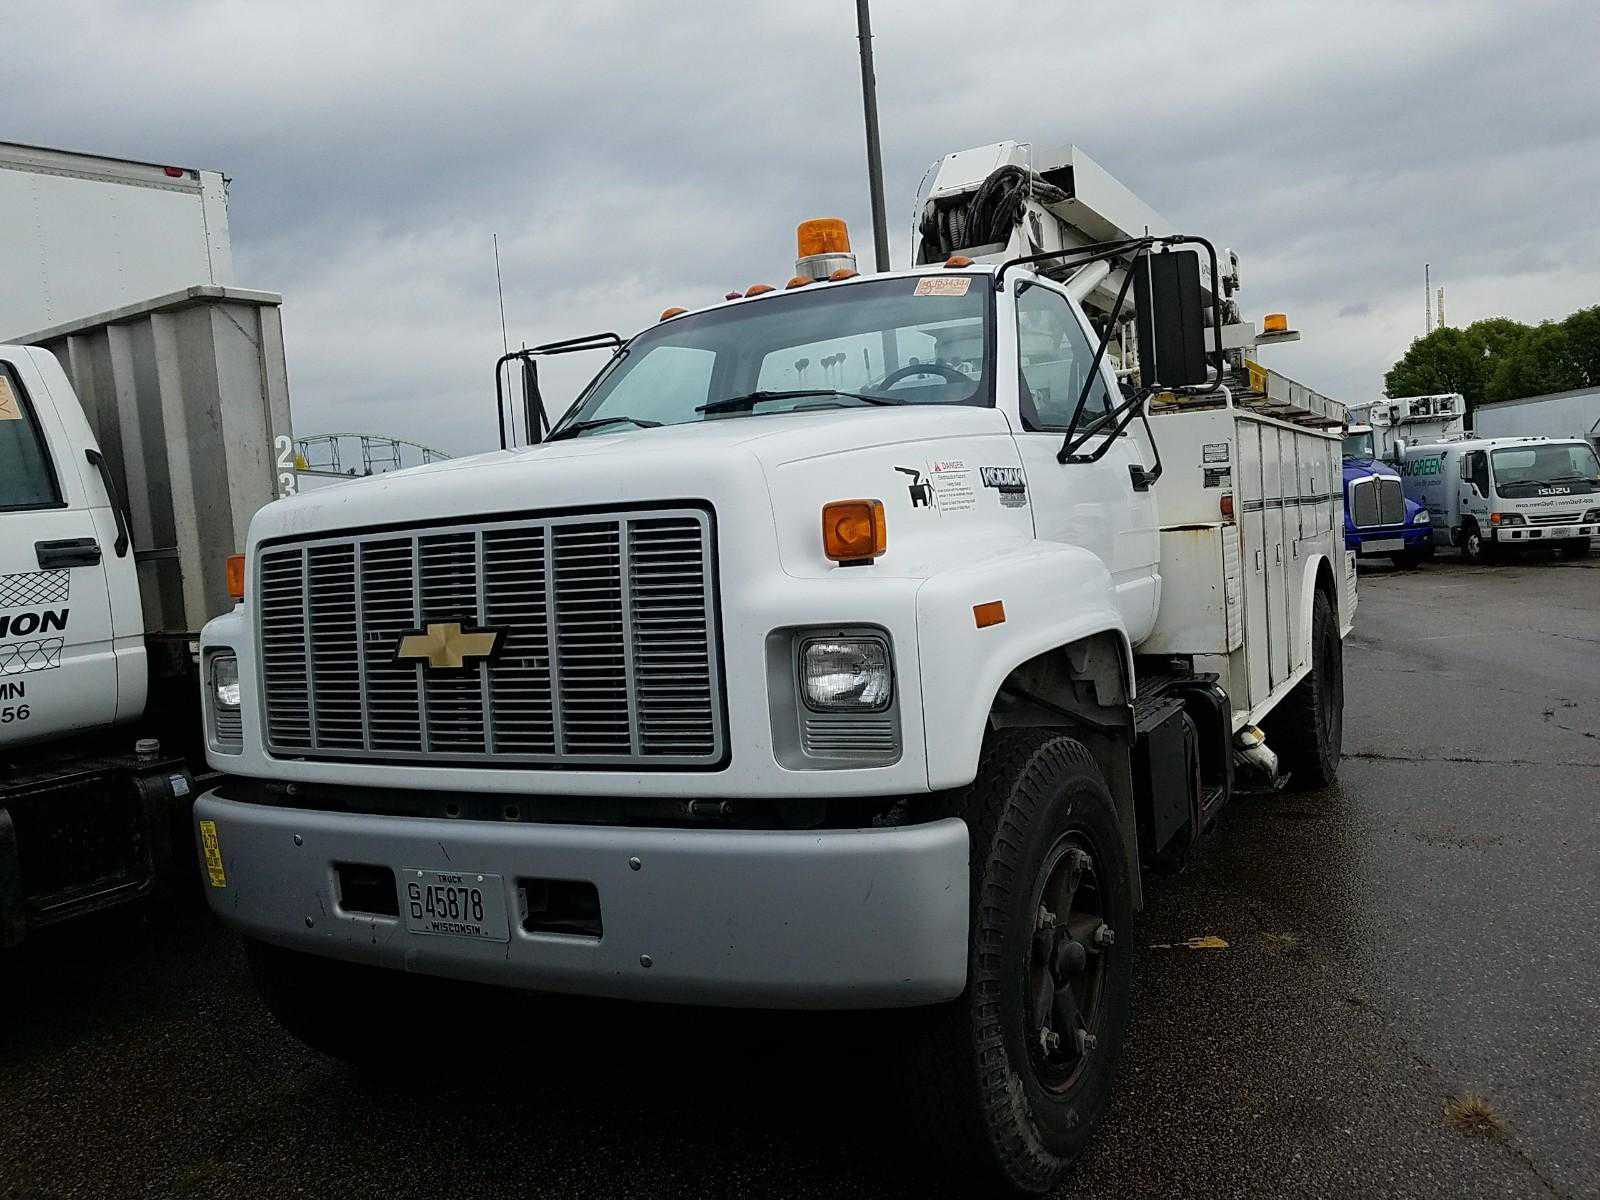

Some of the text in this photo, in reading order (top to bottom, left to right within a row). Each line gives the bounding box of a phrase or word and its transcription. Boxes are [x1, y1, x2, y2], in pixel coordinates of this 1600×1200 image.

[1399, 457, 1441, 477] RUGREEN
[1538, 487, 1570, 495] ISUZU
[438, 874, 464, 884] TRUCK
[426, 885, 484, 921] 45878
[431, 921, 481, 935] WISCONSIN
